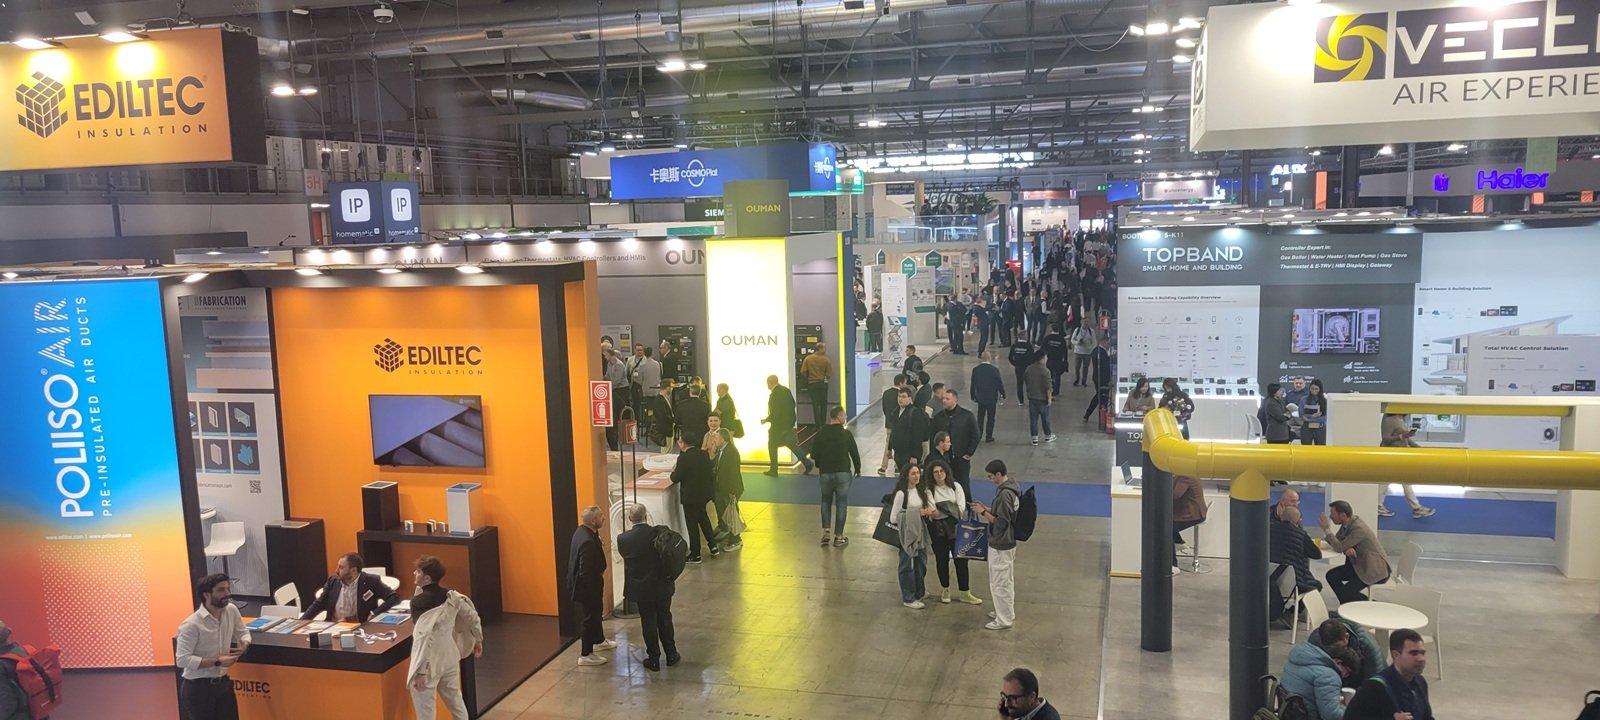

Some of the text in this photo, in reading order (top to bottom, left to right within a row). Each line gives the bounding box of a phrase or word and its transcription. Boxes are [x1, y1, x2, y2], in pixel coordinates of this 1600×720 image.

[74, 75, 206, 121] EDILTEC
[1392, 80, 1449, 106] AIR
[77, 123, 209, 139] INSULATION
[306, 175, 322, 190] 5H
[649, 166, 680, 183] 卡奥斯
[1477, 168, 1550, 190] Haier
[348, 197, 364, 214] IP
[396, 197, 408, 213] IP
[745, 204, 782, 213] OUMAN
[1142, 246, 1244, 262] TOPBAND
[1209, 263, 1243, 271] BUILDING
[721, 335, 779, 346] OUMAN
[407, 345, 482, 366] EDILTEC
[75, 296, 114, 518] PRE-INSULATED AIR DUCTS
[234, 679, 272, 694] DILTEC
